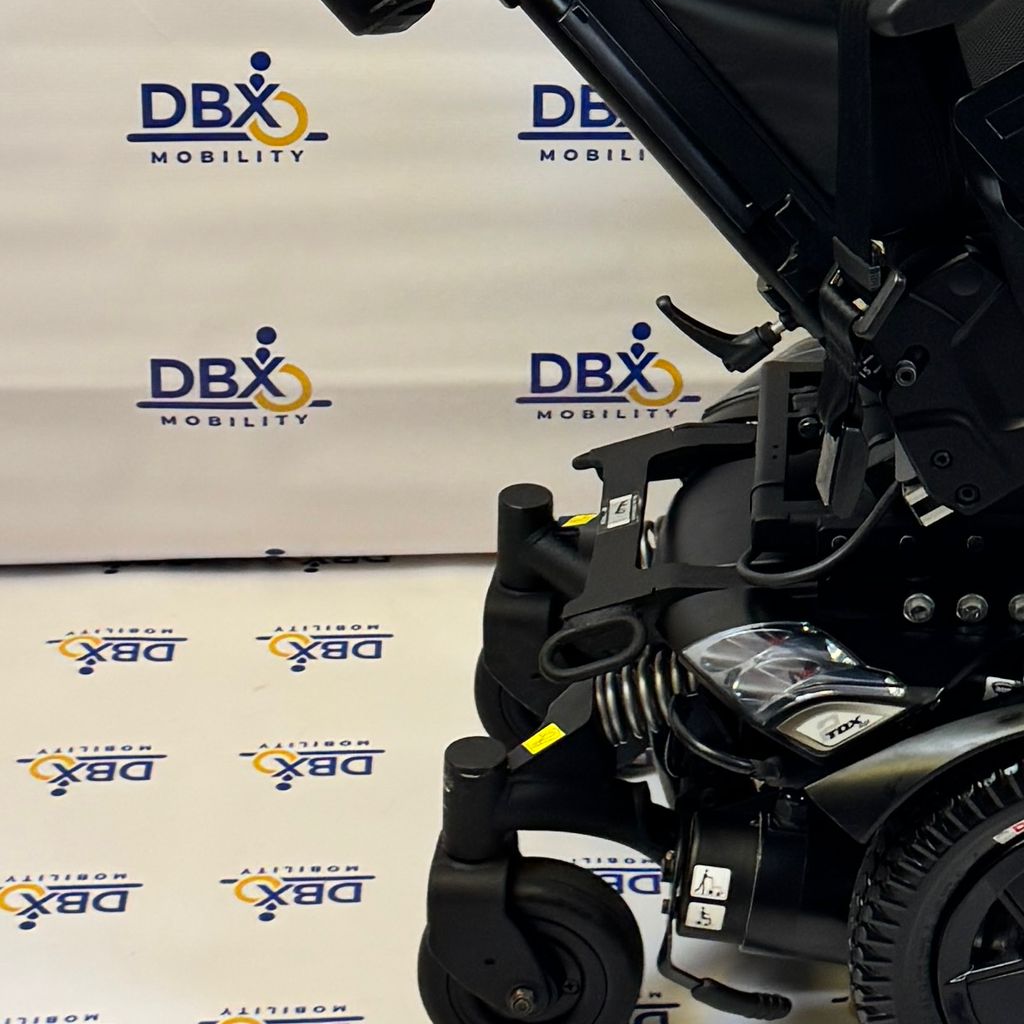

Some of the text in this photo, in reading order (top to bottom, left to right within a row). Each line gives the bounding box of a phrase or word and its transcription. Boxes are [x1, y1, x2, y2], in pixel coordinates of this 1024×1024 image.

[141, 82, 280, 129] DBX
[150, 149, 304, 164] MOBILITY
[150, 357, 286, 399] DBX
[530, 351, 659, 394] DBX
[160, 413, 308, 428] MOBILITY
[536, 407, 678, 420] MOBILITY
[65, 627, 174, 636] MOBILITY
[275, 624, 380, 633] MOBILITY
[75, 642, 176, 662] DBX
[286, 640, 383, 660] DBX
[37, 744, 152, 755] MOBILITY
[260, 740, 370, 750] MOBILITY
[50, 760, 155, 784] DBX
[272, 756, 374, 778] DBX
[5, 872, 128, 883] MOBILITY
[240, 864, 361, 876] MOBILITY
[255, 882, 363, 907] DBX
[16, 890, 129, 917] DBX
[220, 1004, 348, 1017] MOBILITY
